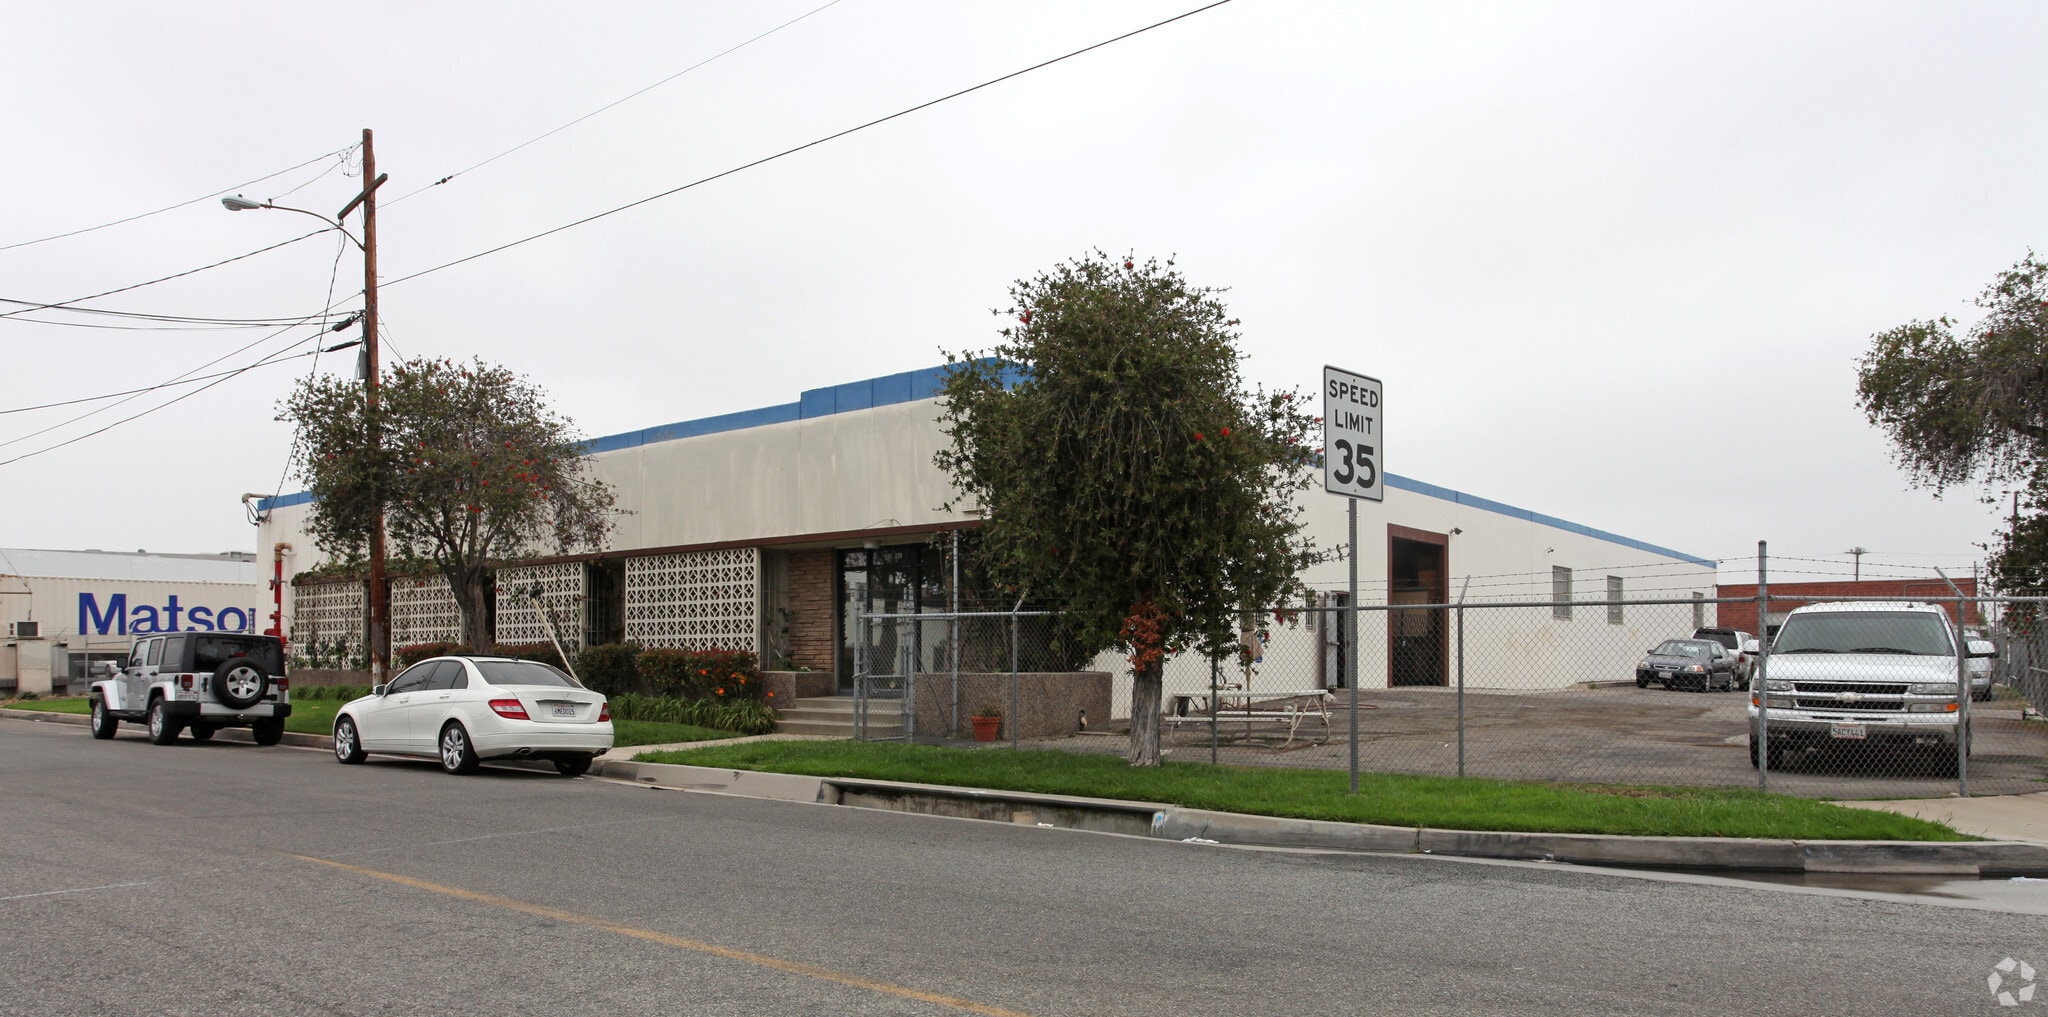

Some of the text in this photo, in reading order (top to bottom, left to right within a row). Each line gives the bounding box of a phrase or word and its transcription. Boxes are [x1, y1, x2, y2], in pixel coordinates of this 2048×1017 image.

[1329, 379, 1378, 408] SPEED
[1335, 409, 1373, 435] LIMIT
[1333, 439, 1376, 489] 35
